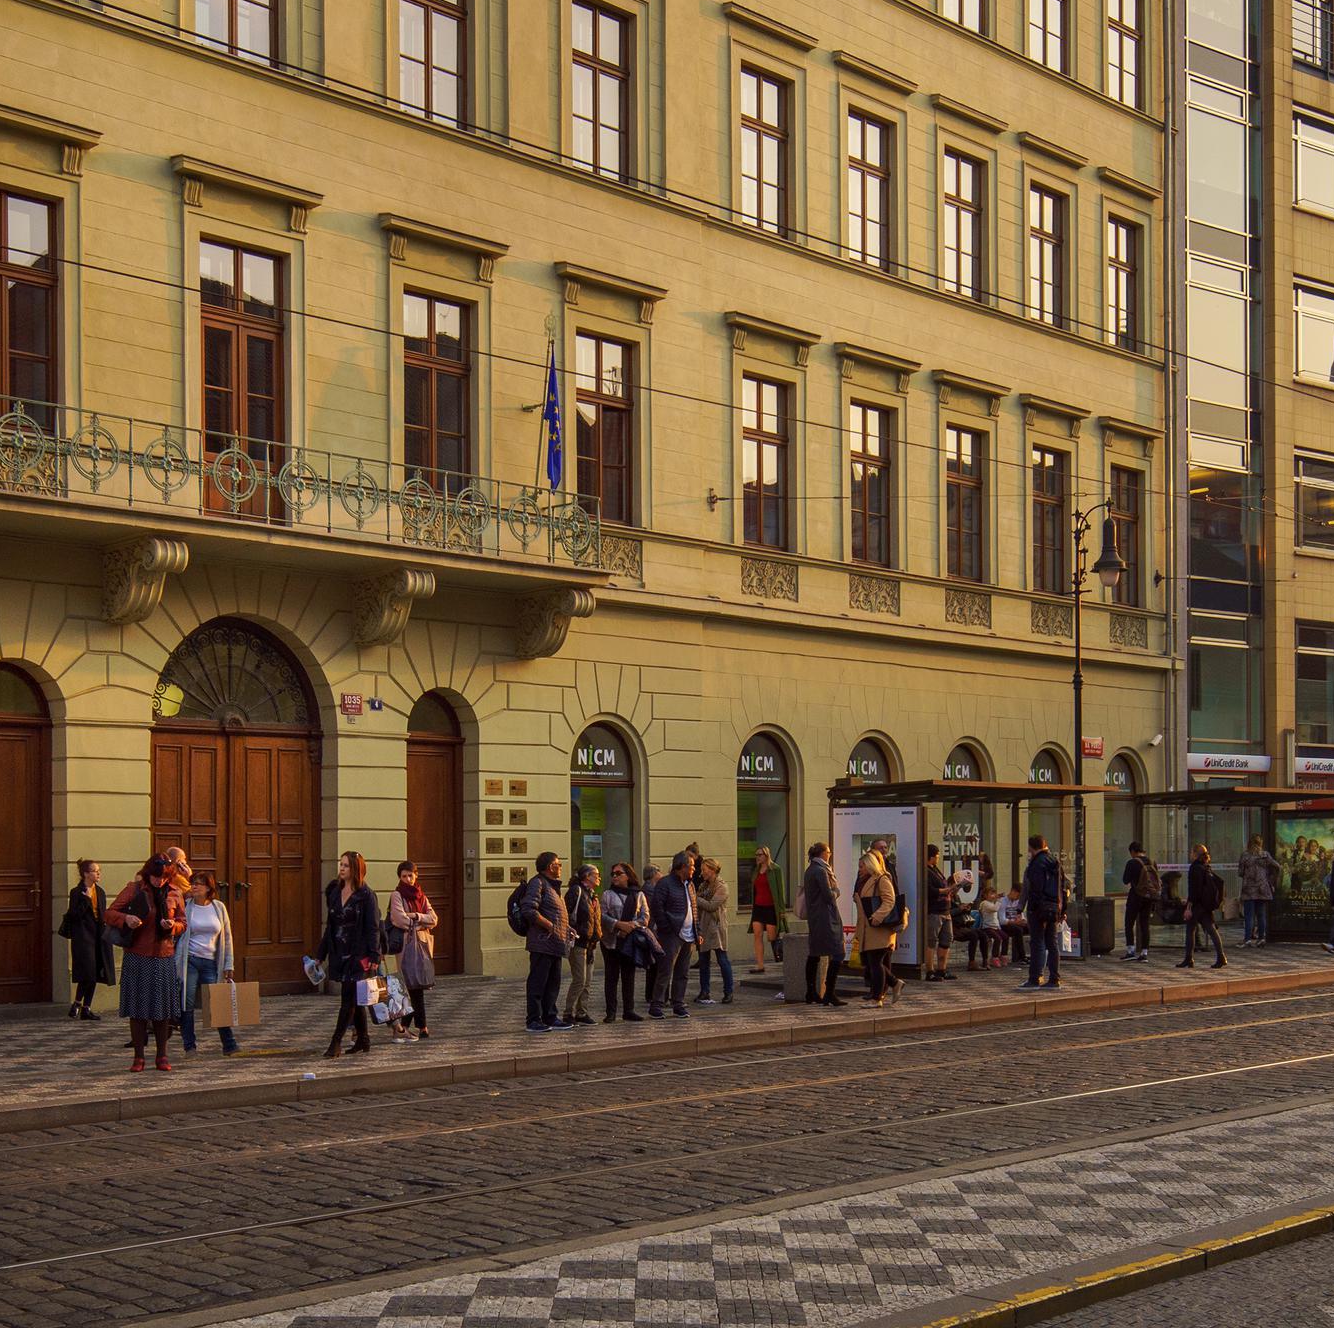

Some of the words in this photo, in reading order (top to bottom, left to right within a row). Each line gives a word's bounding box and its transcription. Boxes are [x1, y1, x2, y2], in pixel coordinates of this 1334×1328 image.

[344, 695, 361, 704] 1035
[1211, 758, 1234, 768] UniCredit
[1235, 759, 1249, 768] Bank
[1311, 762, 1333, 771] UniCredit
[964, 824, 980, 836] ZA
